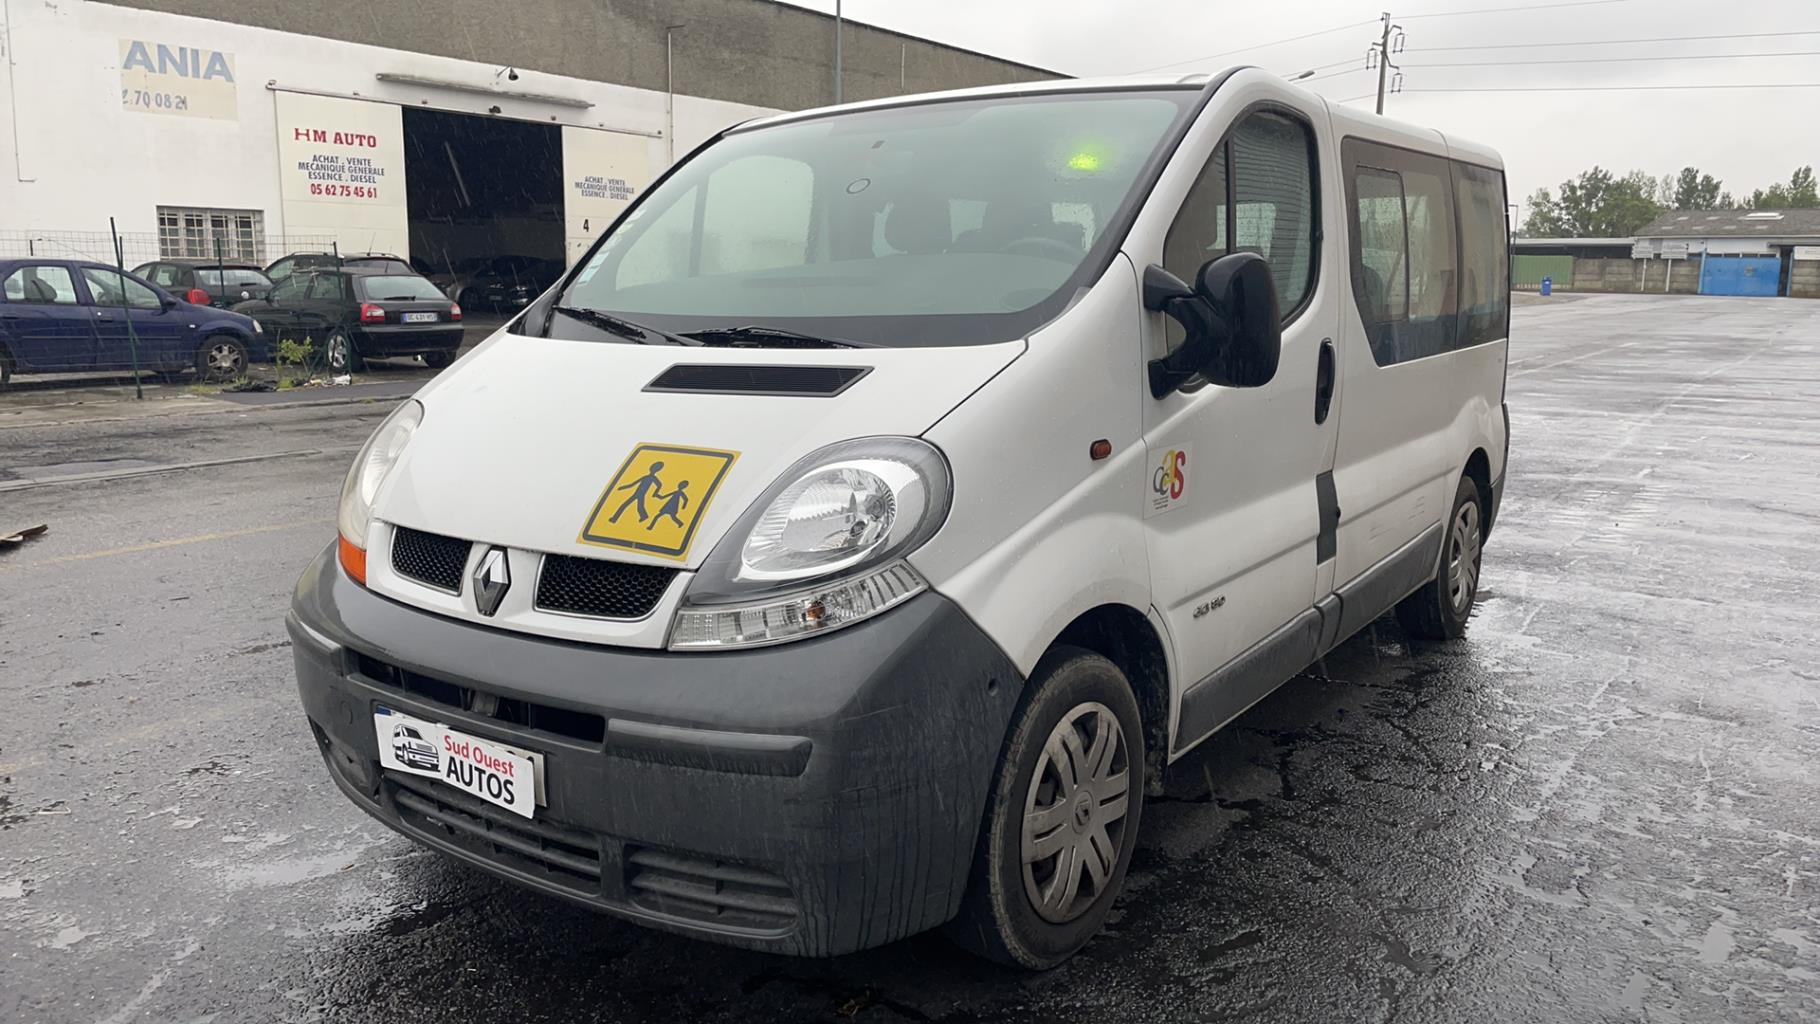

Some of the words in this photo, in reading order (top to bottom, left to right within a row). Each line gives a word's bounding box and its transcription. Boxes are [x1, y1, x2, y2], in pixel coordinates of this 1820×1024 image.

[123, 40, 235, 83] ANIA
[294, 127, 327, 143] HM
[333, 131, 377, 148] AUTO
[312, 154, 339, 164] ACHAT
[346, 157, 372, 167] VENTE
[298, 162, 346, 174] MECANIQUE
[347, 165, 385, 176] GENERALE
[308, 171, 343, 181] ESSENCE
[350, 174, 377, 184] DIESEL
[310, 183, 322, 195] 05
[325, 184, 337, 196] 62
[339, 185, 351, 197] 75
[353, 186, 365, 198] 45
[367, 187, 377, 198] 61
[581, 189, 605, 198] ESSENCE
[583, 219, 589, 232] 4
[444, 735, 470, 760] Sud
[472, 747, 514, 777] Ouest
[446, 756, 515, 805] AUTOS
